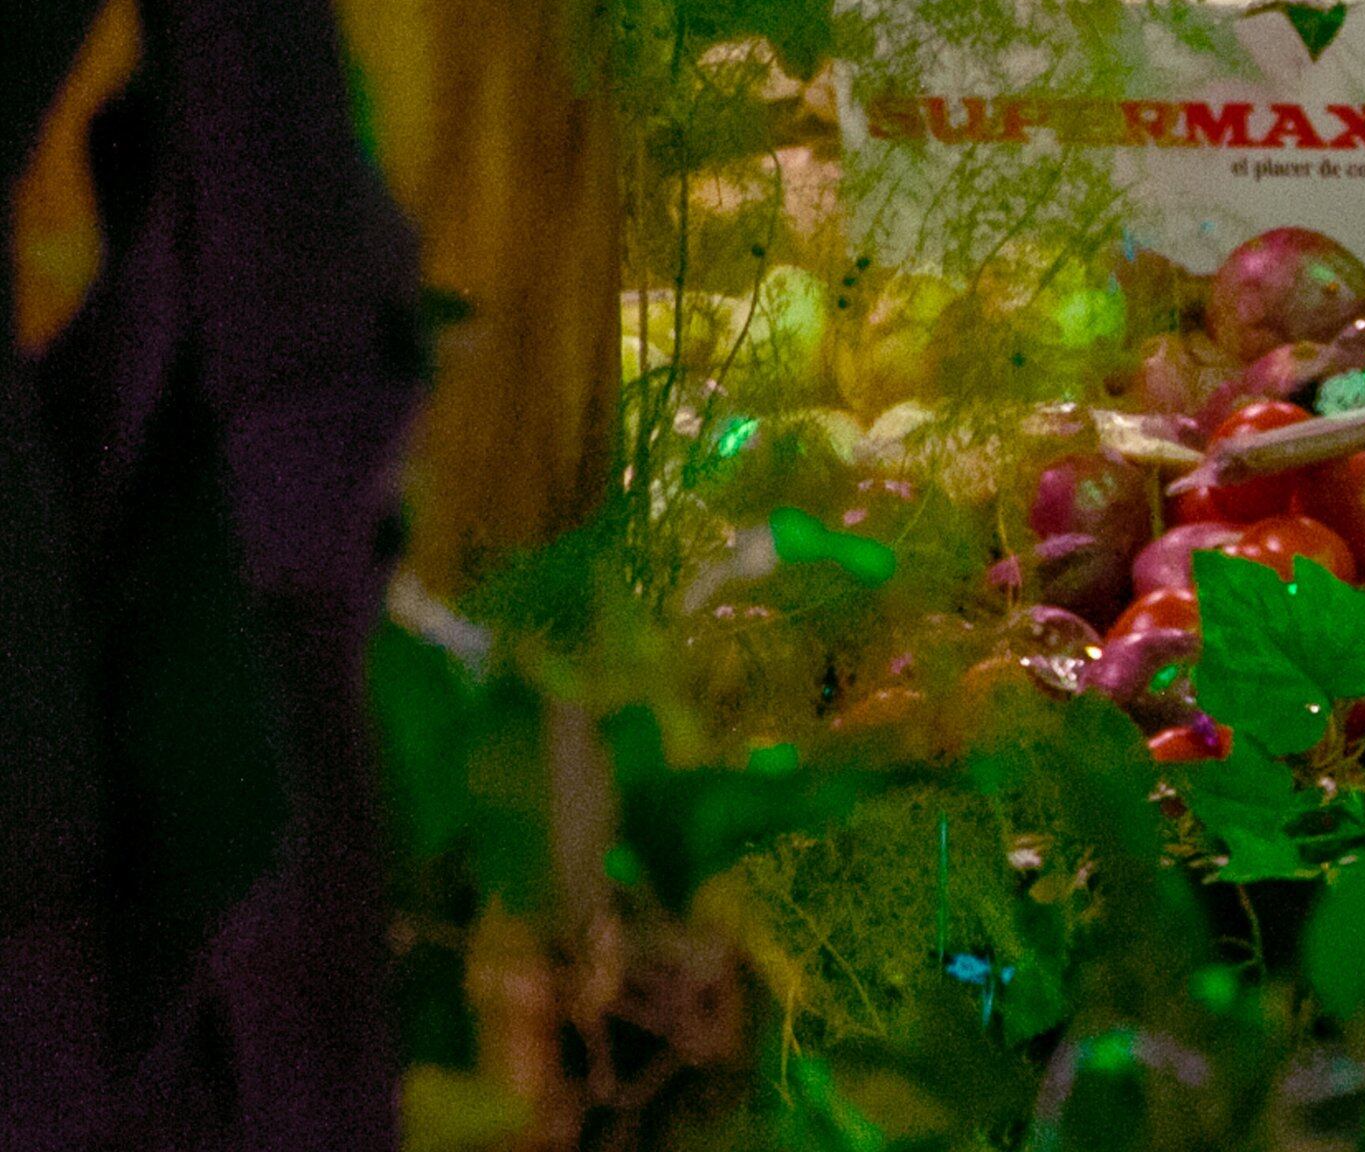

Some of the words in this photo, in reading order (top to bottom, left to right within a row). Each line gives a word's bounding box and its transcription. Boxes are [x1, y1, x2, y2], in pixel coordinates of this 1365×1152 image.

[1231, 158, 1246, 177] el
[1254, 158, 1312, 182] placer
[1319, 158, 1341, 179] de
